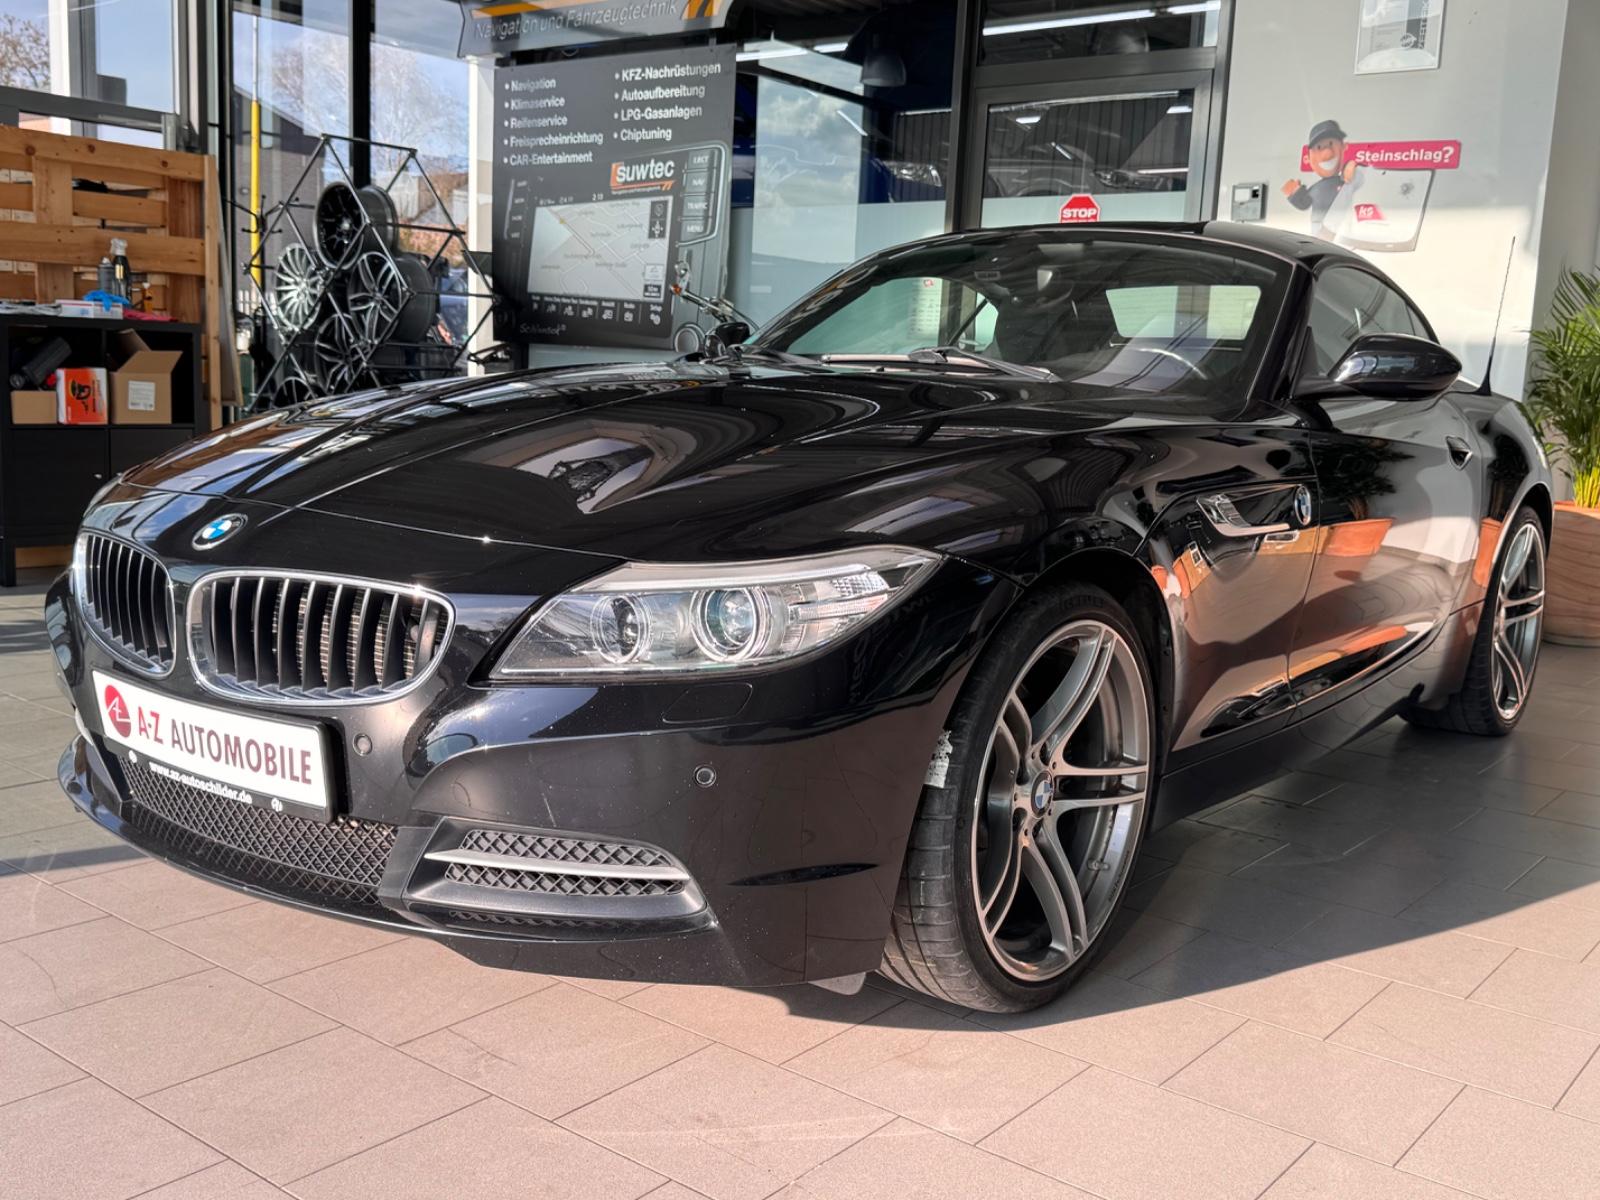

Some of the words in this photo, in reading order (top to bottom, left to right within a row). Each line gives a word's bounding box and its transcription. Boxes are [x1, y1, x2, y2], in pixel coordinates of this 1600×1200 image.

[540, 11, 563, 32] und
[566, 1, 678, 28] Fahrzeugtechnik
[621, 63, 721, 82] KFZ-Nachrüstungen
[511, 78, 556, 92] Navigation
[621, 84, 706, 102] Autoaufbereitung
[510, 95, 566, 110] Klimaservice
[510, 114, 568, 129] Reifenservice
[620, 105, 703, 121] LPG-Gasanlagen
[510, 131, 604, 149] Freisprecheinrichtung
[620, 127, 673, 142] Chiptuning
[510, 150, 593, 166] CAR-Entertainment
[1355, 146, 1454, 164] Steinschlag?
[616, 159, 675, 183] suwtec
[1062, 207, 1098, 219] STOP
[138, 706, 164, 745] A-Z
[171, 718, 313, 786] AUTOMOBILE
